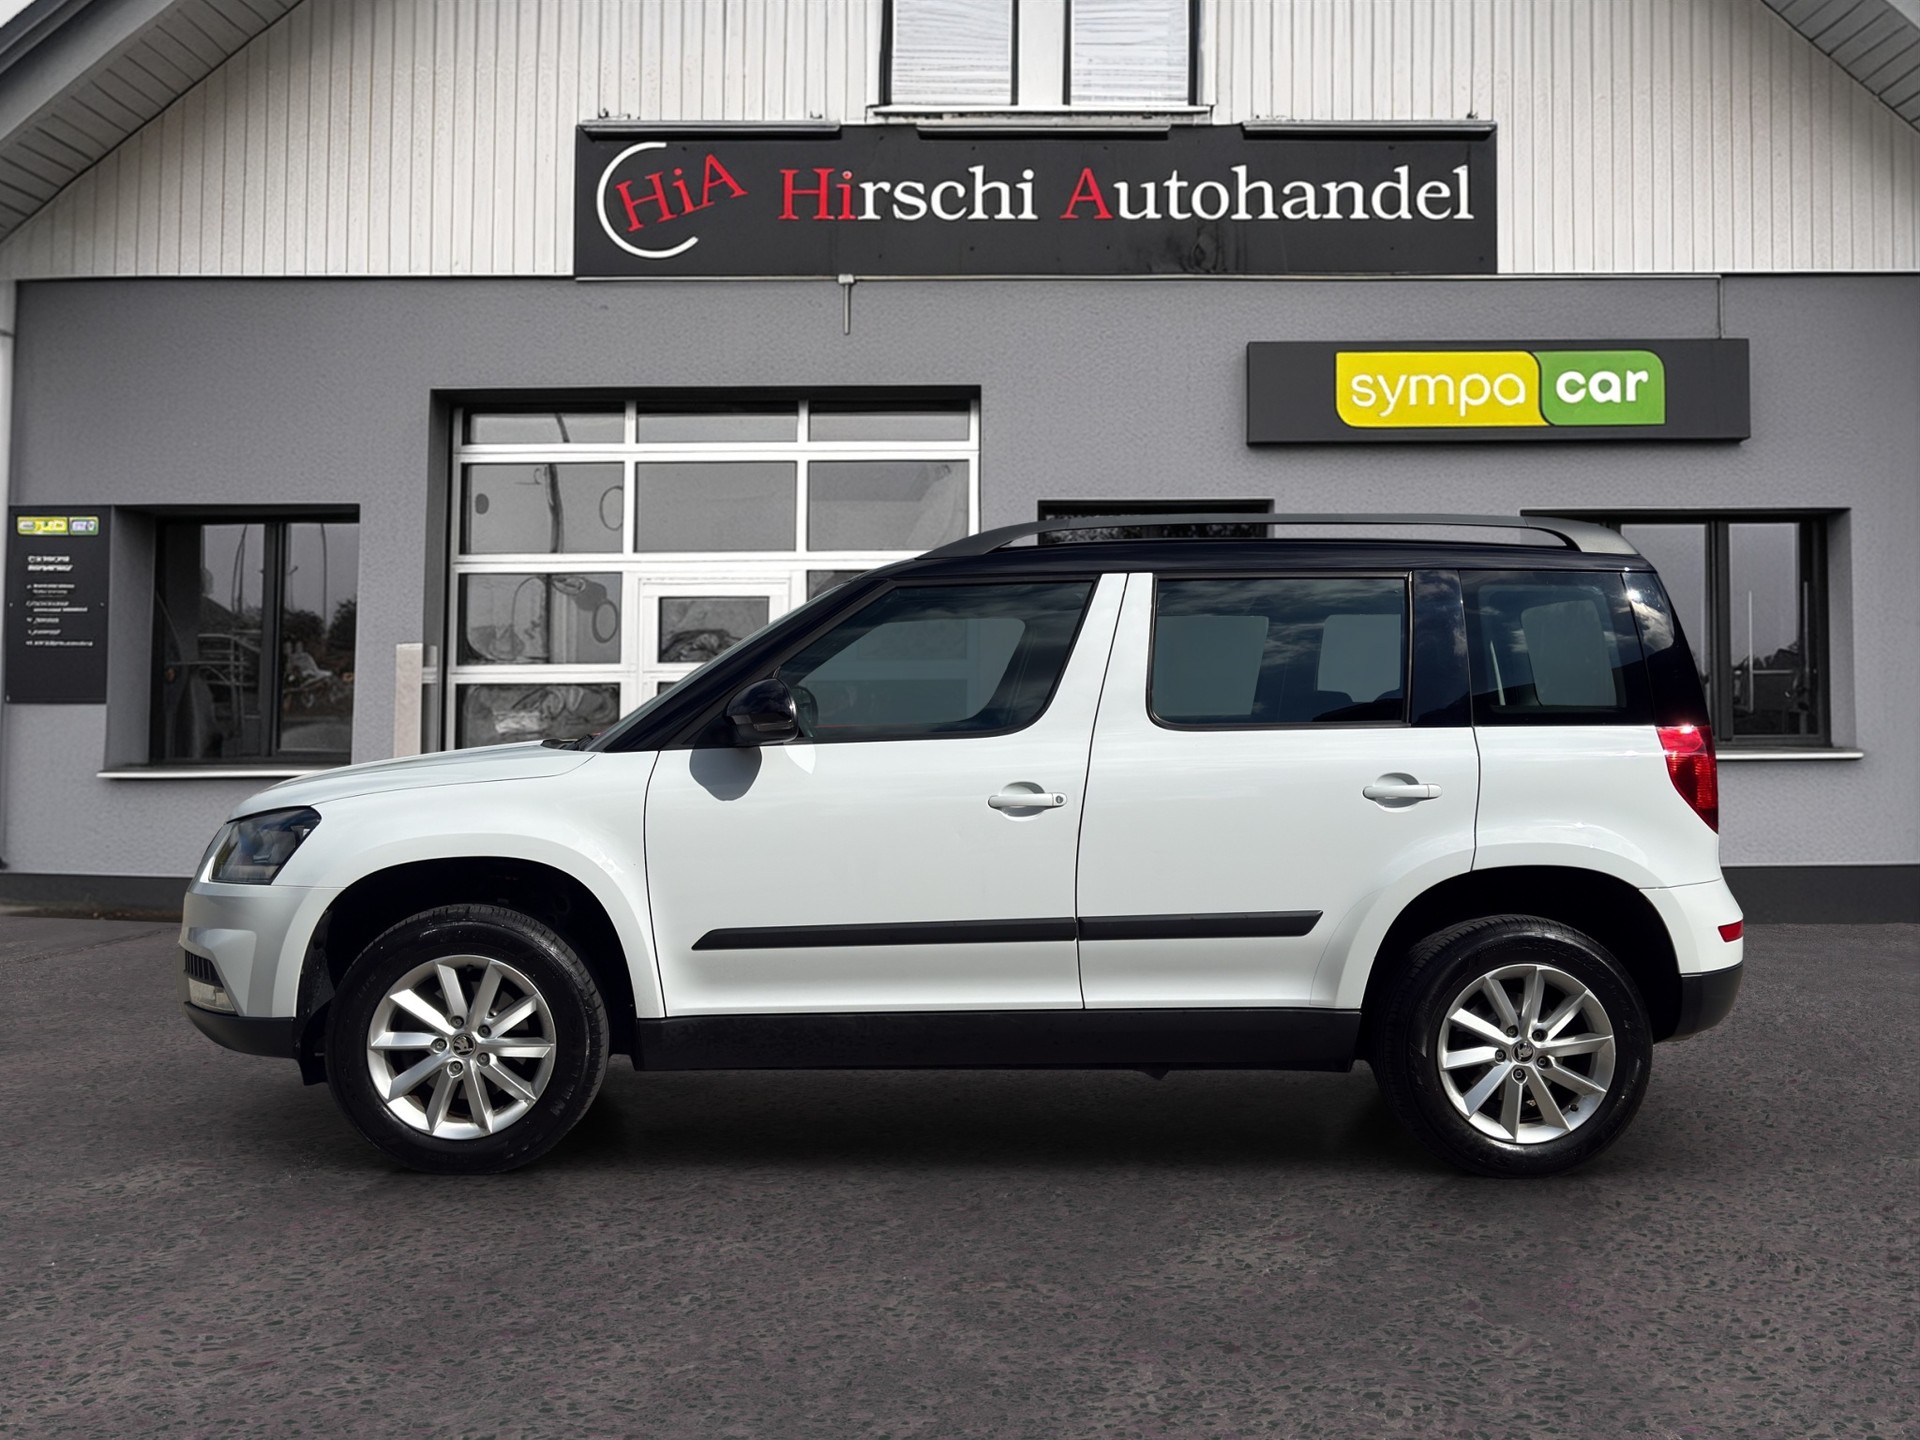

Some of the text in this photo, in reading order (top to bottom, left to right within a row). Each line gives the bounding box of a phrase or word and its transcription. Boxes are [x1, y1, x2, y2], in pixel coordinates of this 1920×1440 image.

[615, 153, 748, 232] HiA
[777, 165, 1475, 221] Hirschi Autohandel
[1351, 370, 1649, 418] sympa car
